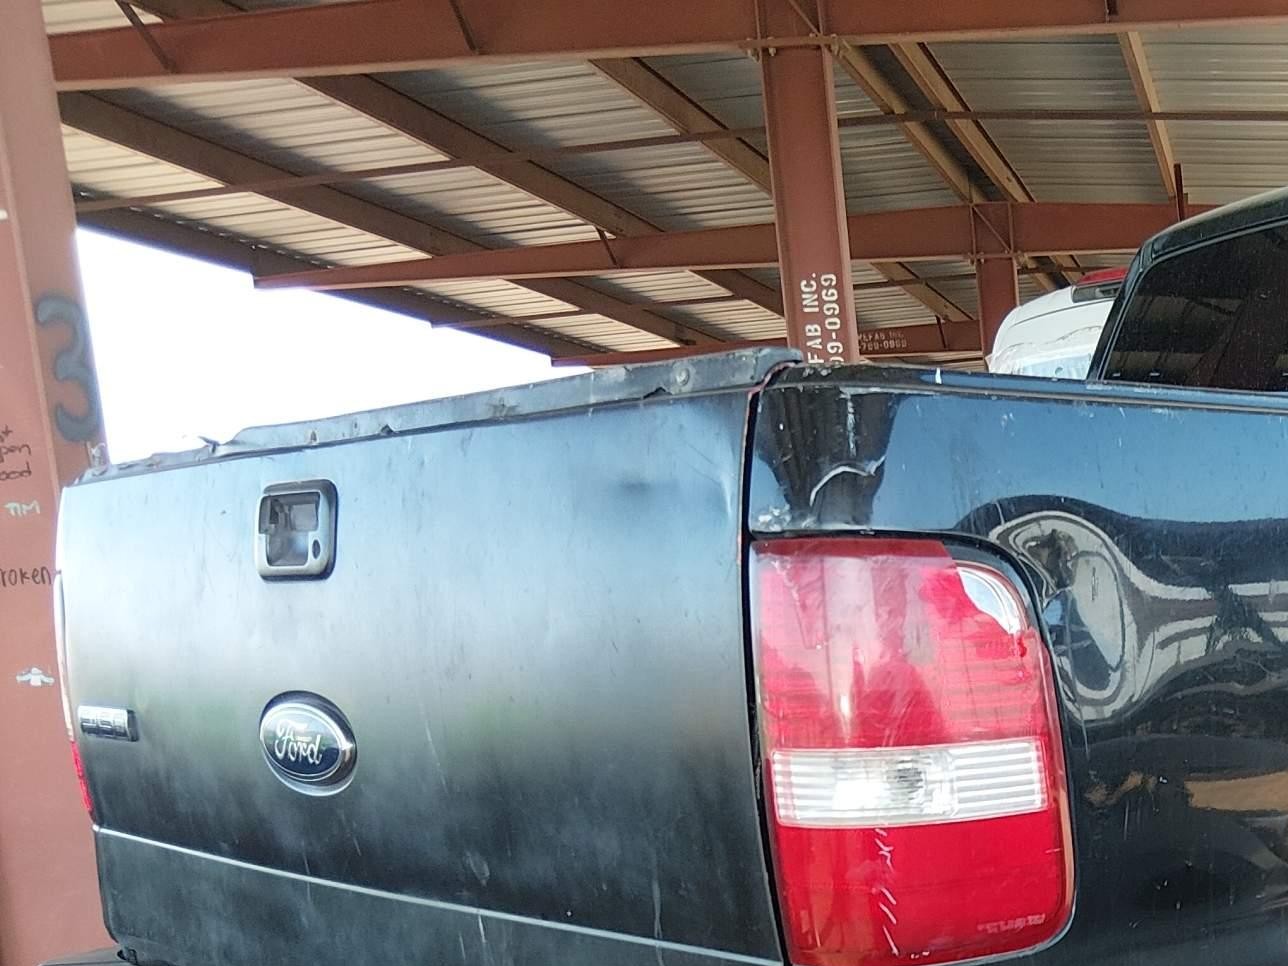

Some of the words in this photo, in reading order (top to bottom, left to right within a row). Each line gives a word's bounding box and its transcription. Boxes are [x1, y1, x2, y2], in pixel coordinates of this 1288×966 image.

[801, 273, 819, 312] INC.
[36, 292, 101, 442] 3
[275, 719, 323, 765] Ford
